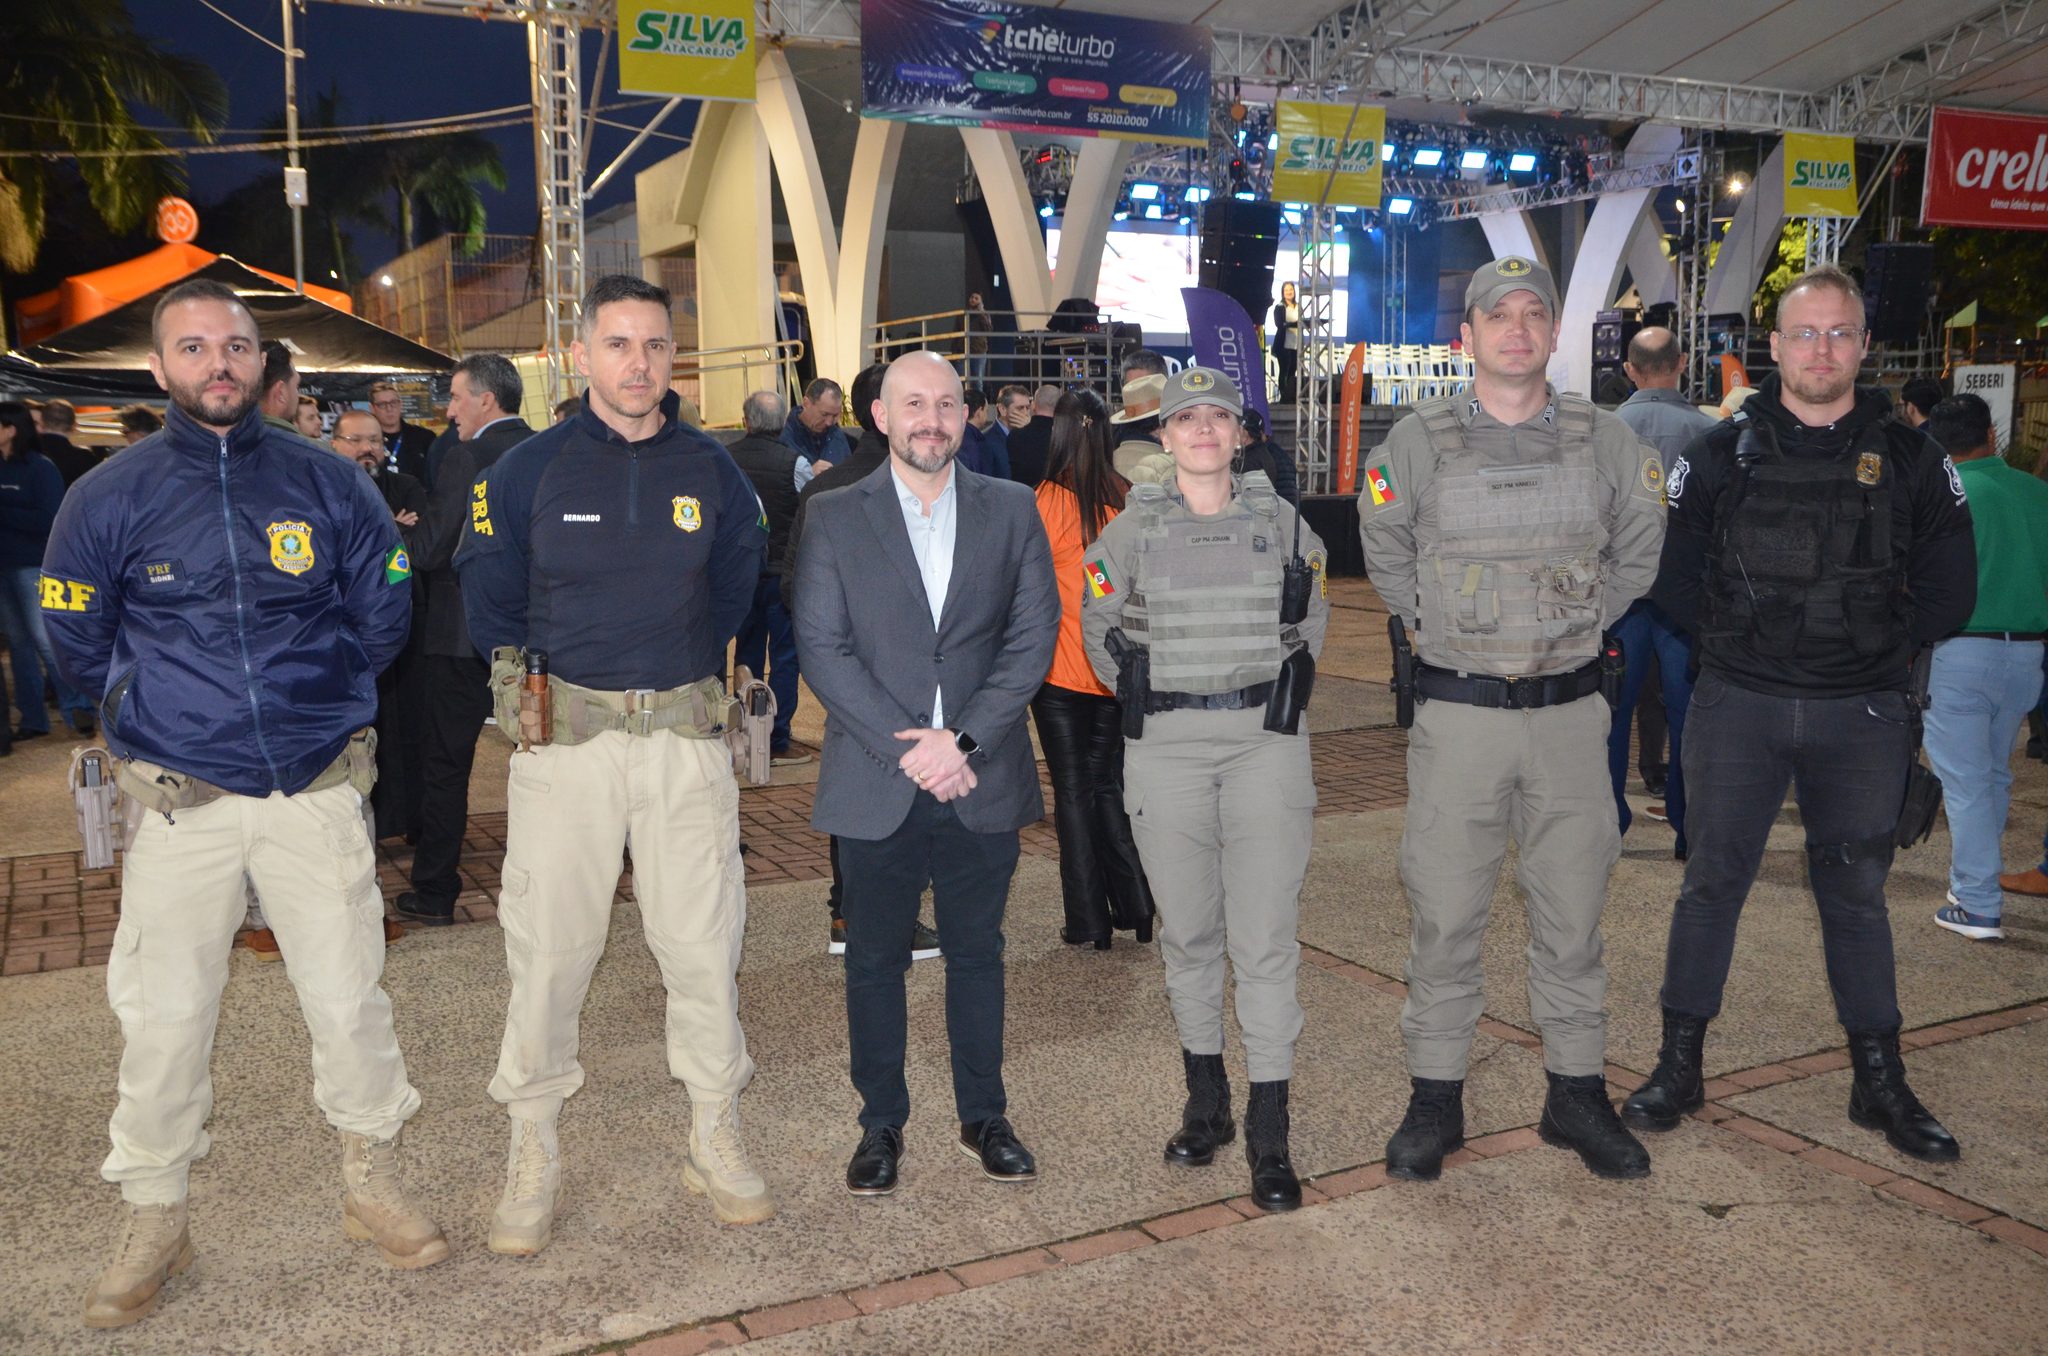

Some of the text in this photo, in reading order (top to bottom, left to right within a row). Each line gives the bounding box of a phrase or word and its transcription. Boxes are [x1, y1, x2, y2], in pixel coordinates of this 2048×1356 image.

[629, 11, 747, 51] SILVA
[663, 43, 736, 58] ATACAREJO
[991, 105, 1072, 119] www.tcheturbo.com.br
[1100, 112, 1149, 127] 2010.0000
[1282, 137, 1376, 169] SILVA
[1790, 160, 1852, 186] SILVA
[1990, 198, 2010, 209] Uma
[1966, 373, 2004, 389] SEBERI
[472, 480, 494, 536] PRF
[563, 513, 601, 522] BERNARDO
[147, 563, 171, 576] PRF
